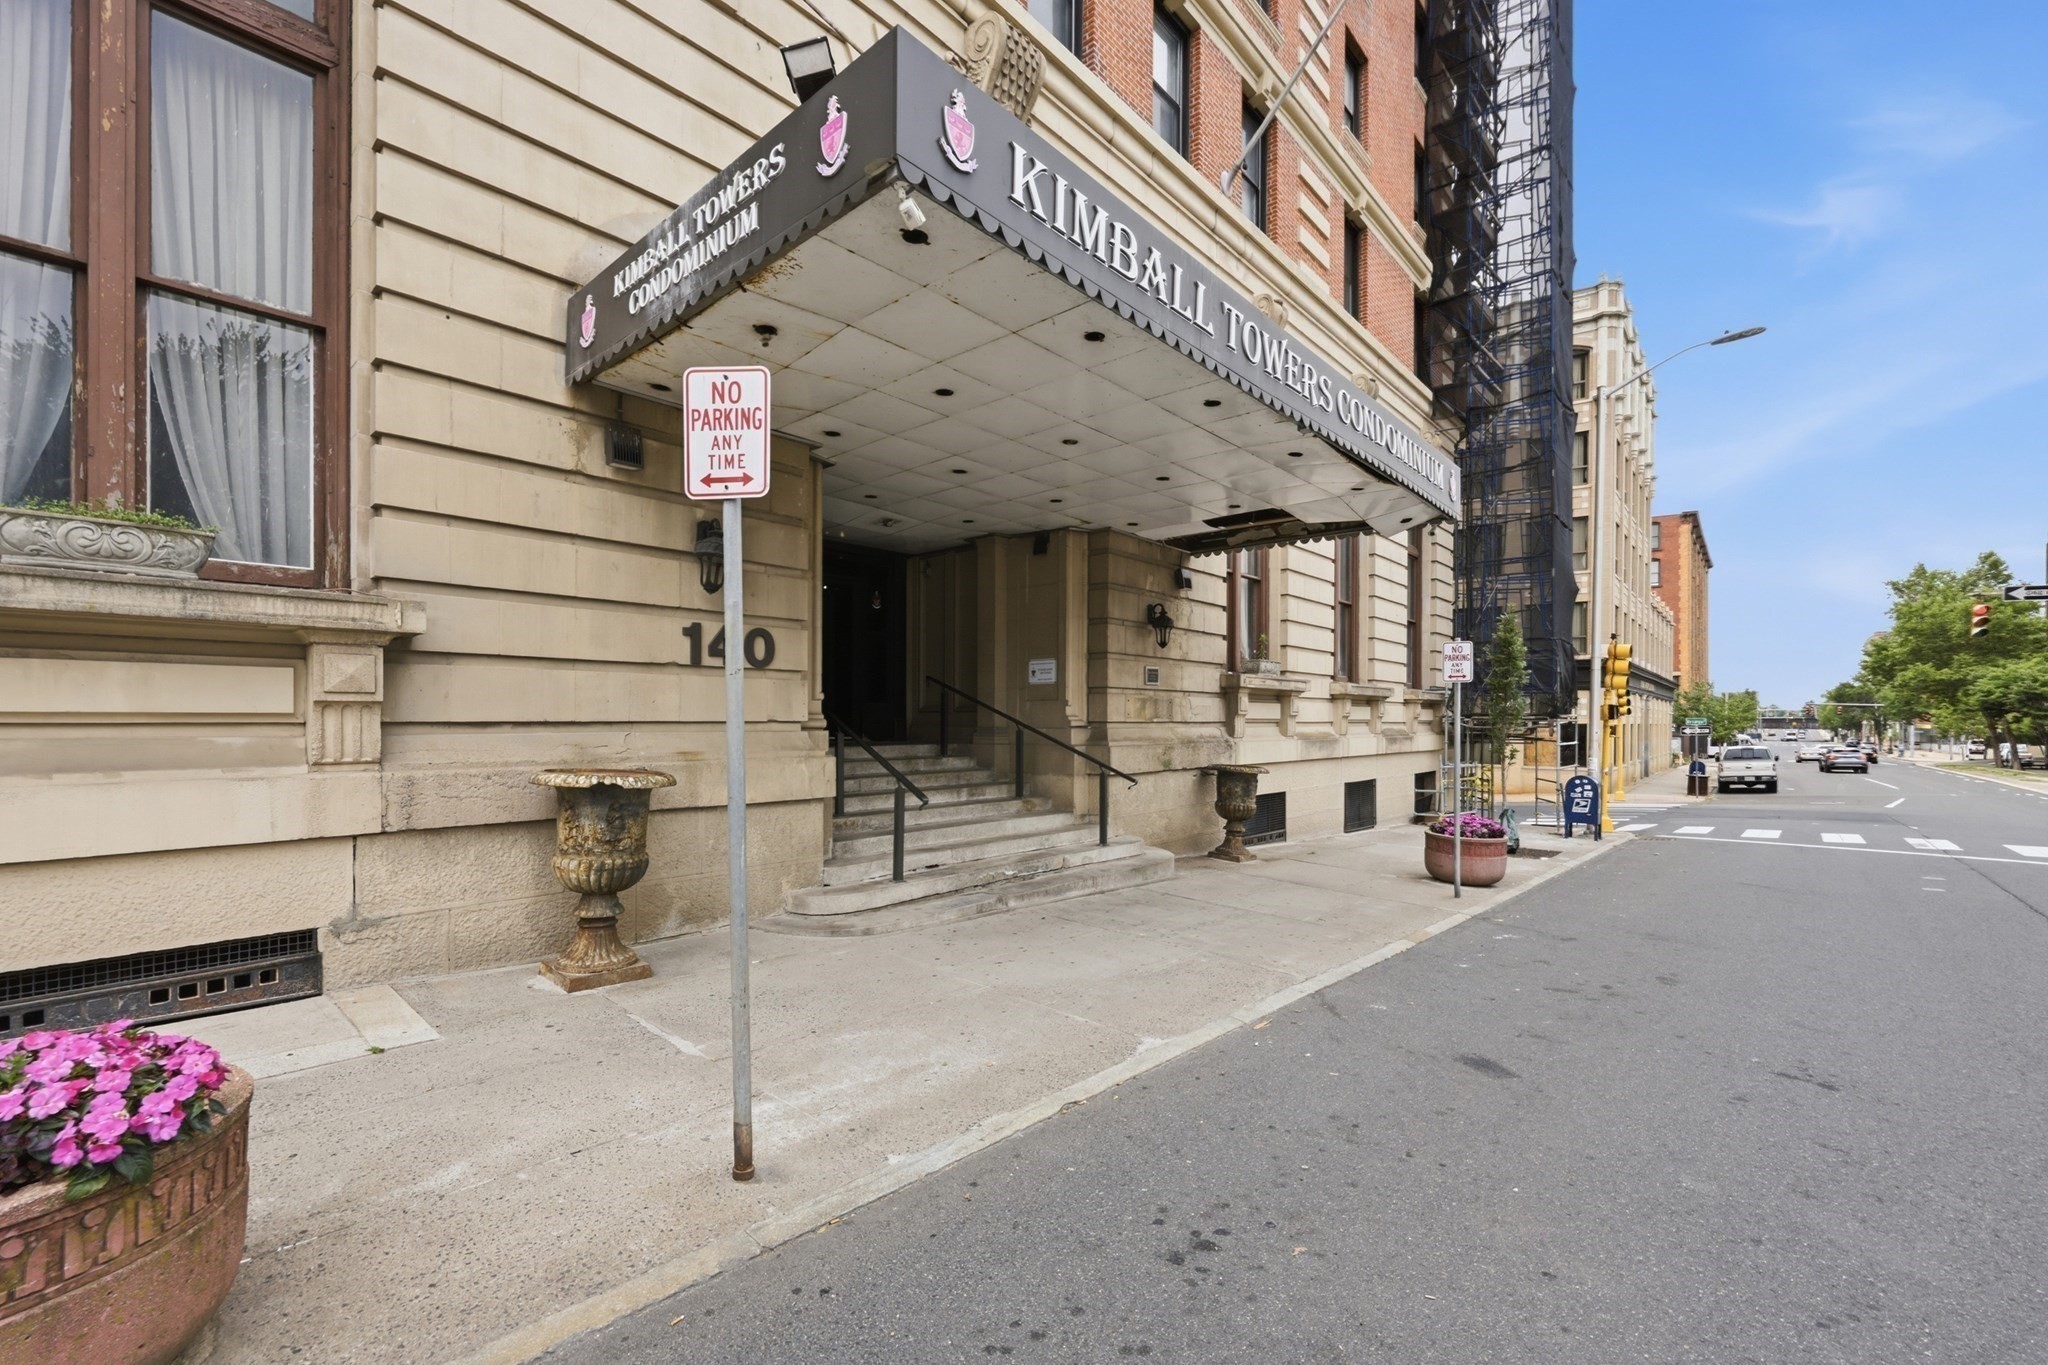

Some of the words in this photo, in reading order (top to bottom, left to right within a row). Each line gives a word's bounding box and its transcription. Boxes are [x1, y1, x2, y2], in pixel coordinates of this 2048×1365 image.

[612, 220, 690, 298] KIMBALL
[692, 142, 787, 234] TOWERS
[628, 201, 760, 315] CONDOMINIUM
[1008, 140, 1215, 339] KIMBALL
[1220, 300, 1334, 414] TOWERS
[1336, 389, 1444, 491] CONDOMINIUM
[711, 381, 742, 404] NO
[691, 407, 763, 432] PARKING
[711, 434, 743, 450] ANY
[708, 453, 746, 470] TIME
[1444, 654, 1471, 662] PARKING
[1451, 645, 1463, 654] NO
